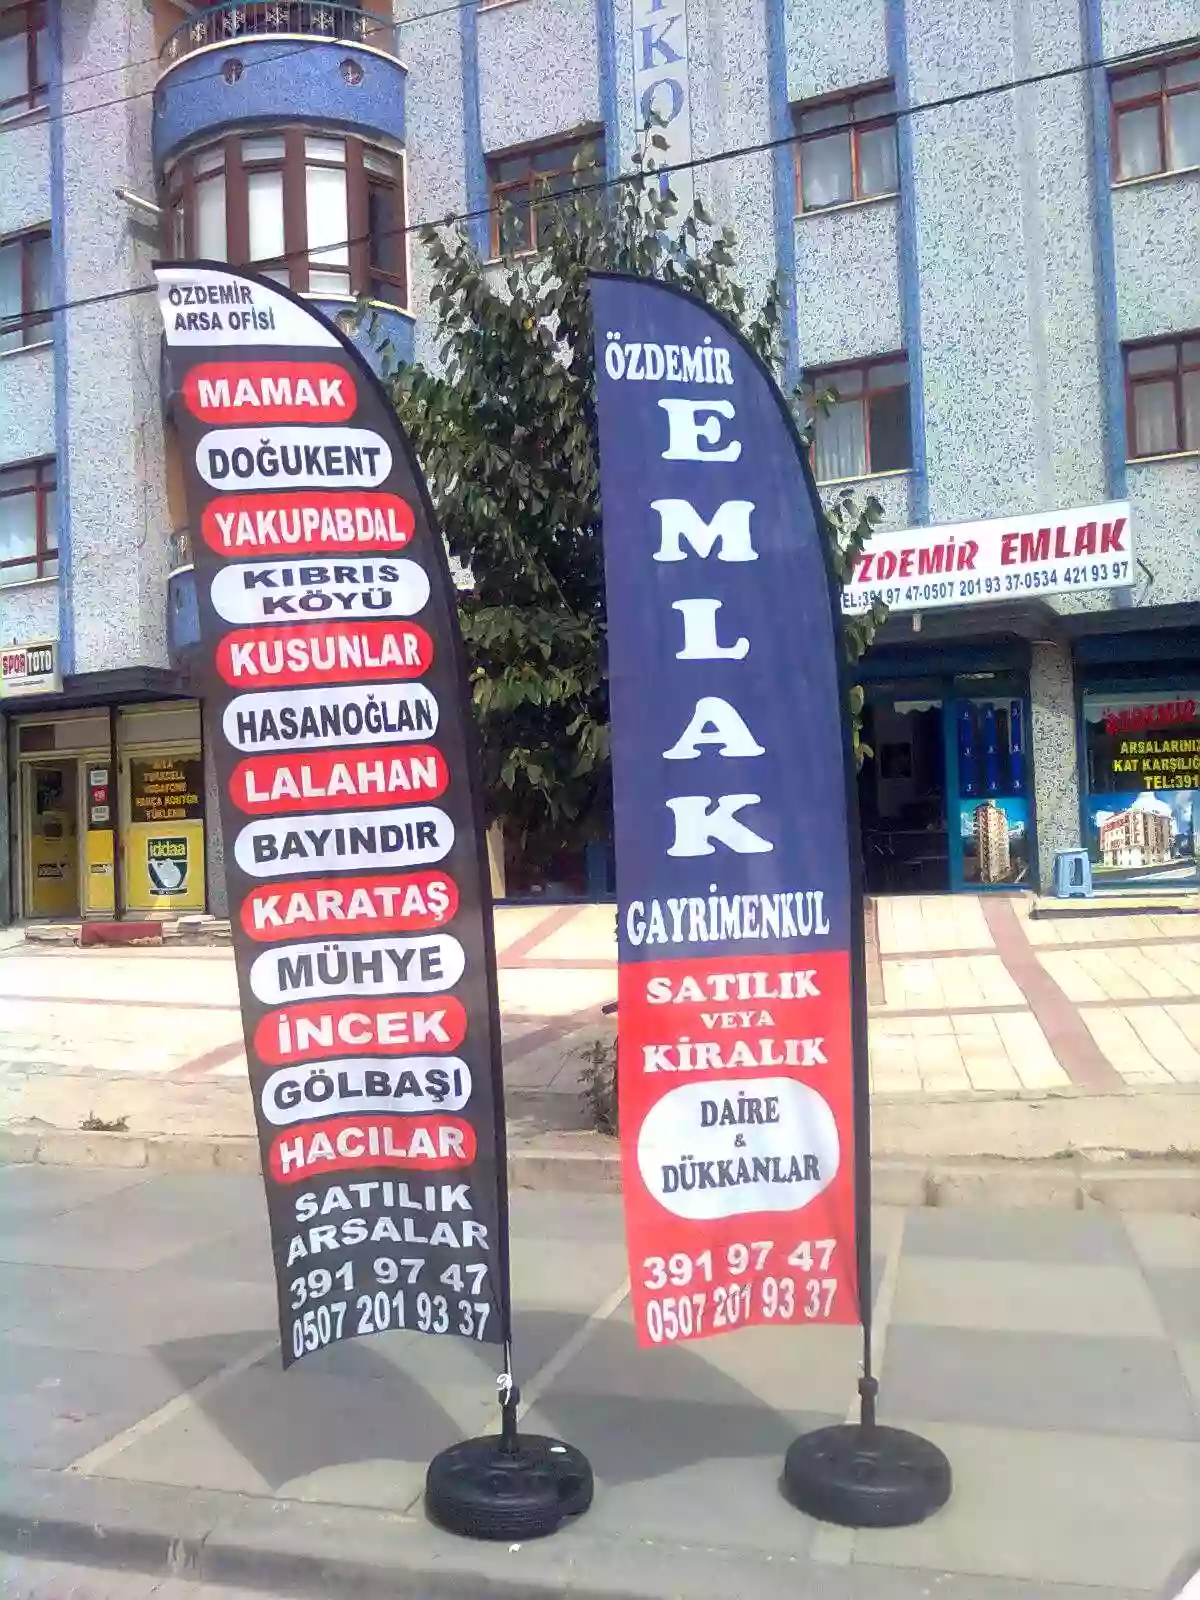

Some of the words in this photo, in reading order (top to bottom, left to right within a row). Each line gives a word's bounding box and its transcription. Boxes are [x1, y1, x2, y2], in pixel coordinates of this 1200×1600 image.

[168, 281, 254, 306] ÖZDEMİR
[174, 311, 224, 331] ARSA
[228, 306, 275, 331] OFİSİ
[605, 331, 735, 385] ÖZDEMİR
[198, 377, 346, 408] MAMAK
[208, 438, 381, 481] DOĞUKENT
[214, 507, 406, 547] YAKUPABDAL
[1000, 517, 1128, 566] EMLAK
[243, 564, 400, 589] KIBRIS
[886, 587, 901, 604] 97
[905, 581, 955, 601] 47-0507
[959, 577, 982, 597] 201
[984, 575, 1001, 594] 93
[1005, 569, 1058, 591] 37-0534
[1063, 566, 1088, 585] 421
[1091, 563, 1109, 582] 93
[1112, 560, 1129, 579] 97
[262, 587, 393, 615] KÖYÜ
[650, 398, 774, 857] EMLAK
[230, 633, 422, 677] KUSUNLAR
[236, 694, 434, 744] HASANOĞLAN
[244, 756, 438, 803] LALAHAN
[252, 820, 440, 864] BAYINDIR
[252, 881, 450, 930] KARATAŞ
[626, 883, 830, 946] GAYRİMENKUL
[277, 944, 443, 991] MÜHYE
[646, 969, 821, 1004] SATILIK
[278, 1009, 451, 1054] İNCEK
[699, 1010, 775, 1030] VEYA
[641, 1035, 828, 1073] KİRALIK
[273, 1067, 463, 1110] GÖLBAŞI
[699, 1090, 780, 1128] DAİRE
[279, 1125, 466, 1175] HACILAR
[733, 1133, 747, 1148] &
[661, 1154, 822, 1193] DÜKKANLAR
[295, 1181, 473, 1222] SATILIK
[287, 1217, 490, 1267] ARSALAR
[642, 1249, 713, 1289] 391
[726, 1240, 774, 1276] 97
[787, 1238, 837, 1273] 47
[290, 1261, 354, 1310] 391
[373, 1257, 425, 1284] 97
[439, 1263, 489, 1295] 47
[291, 1301, 348, 1359] 0507
[356, 1290, 406, 1334] 201
[416, 1291, 450, 1334] 93
[457, 1301, 491, 1341] 37
[645, 1292, 708, 1343] 0507
[711, 1282, 753, 1331] 201
[761, 1276, 796, 1319] 93
[804, 1278, 838, 1318] 37
